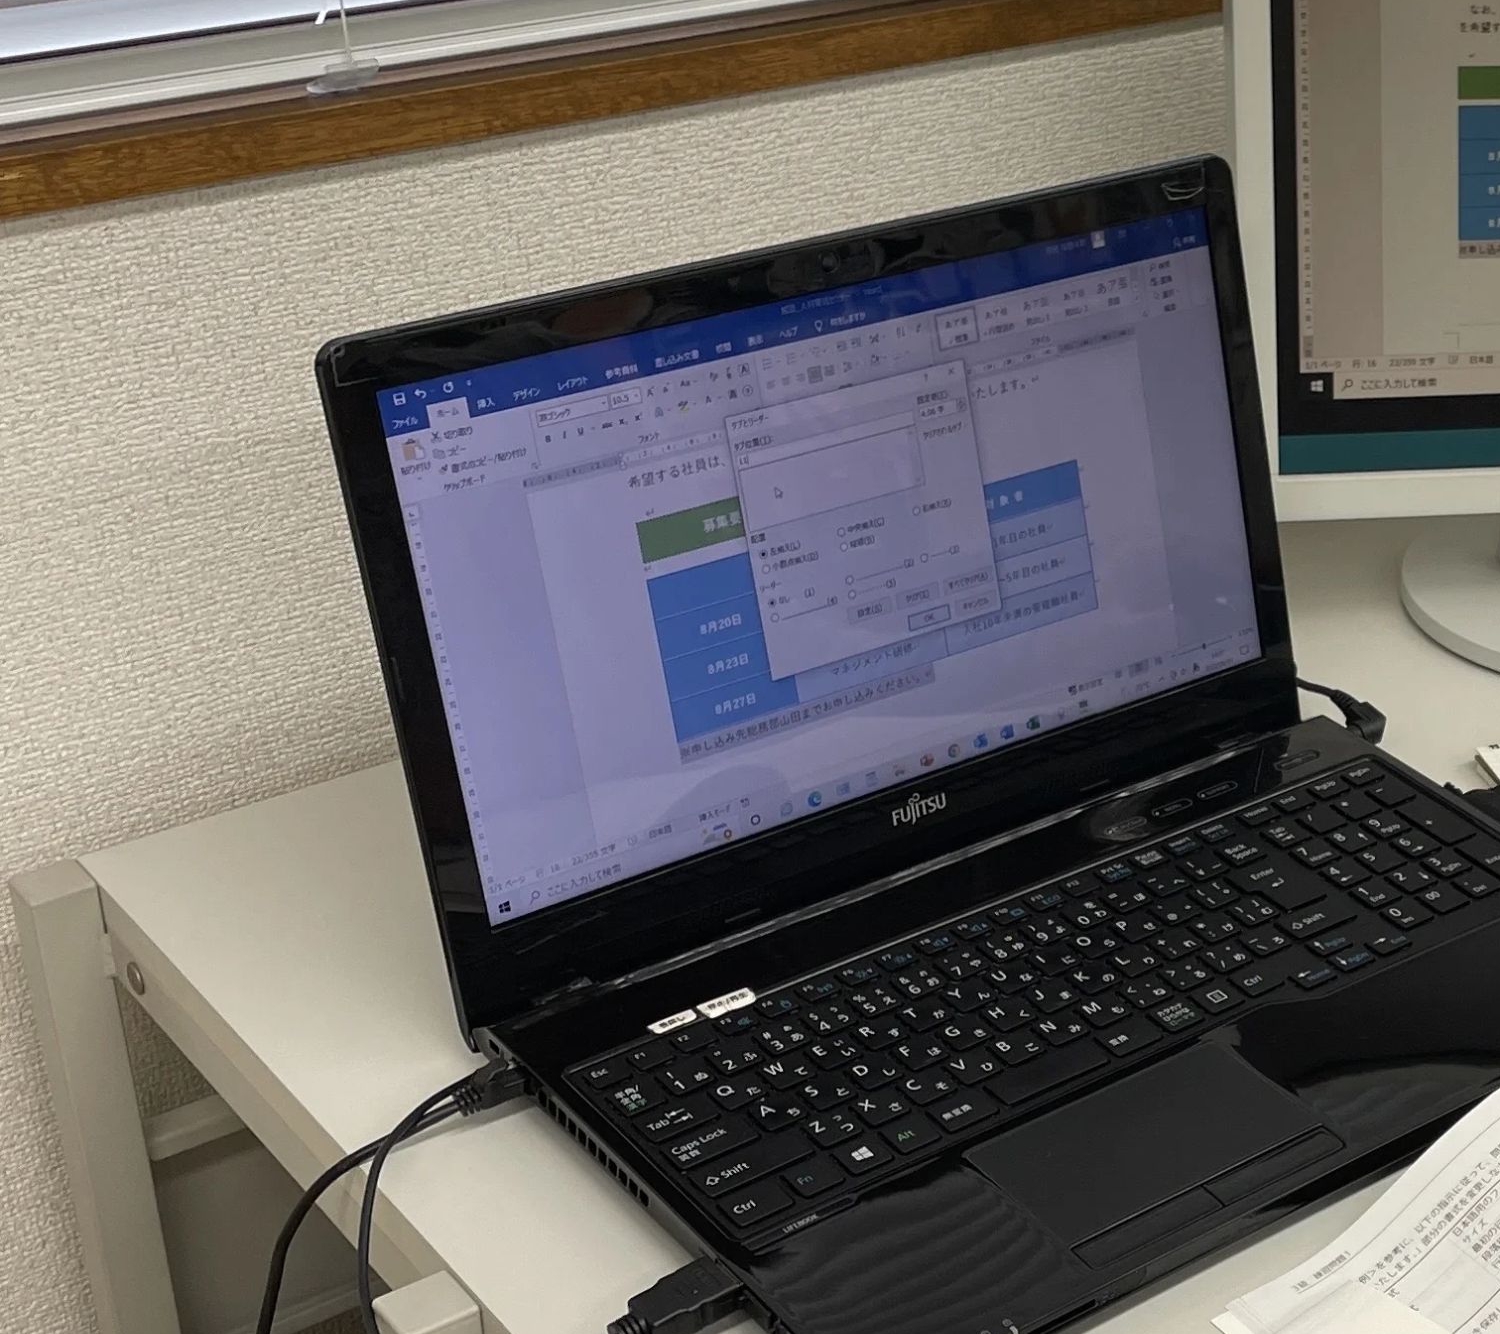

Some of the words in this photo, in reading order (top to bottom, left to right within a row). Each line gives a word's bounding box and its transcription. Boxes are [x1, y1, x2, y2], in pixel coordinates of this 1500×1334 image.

[556, 375, 589, 393] レイアウト
[512, 385, 542, 401] デザイン
[476, 397, 496, 411] 挿入
[391, 415, 420, 430] ファイル
[627, 453, 728, 491] 希望する社員は、
[700, 612, 744, 637] 8月20日
[707, 652, 750, 675] 8月23日
[714, 691, 757, 716] 8月27日
[891, 792, 948, 827] FUJITSU
[1249, 866, 1275, 881] Enter
[1301, 911, 1327, 927] Shift
[1075, 935, 1092, 948] O
[1243, 974, 1264, 989] Ctrl
[904, 1007, 918, 1019] T
[988, 1006, 1006, 1020] H
[1081, 1000, 1103, 1016] M
[1039, 1019, 1058, 1035] N
[590, 1067, 609, 1080] Esc
[763, 1061, 786, 1077] W
[716, 1084, 734, 1097] Q
[804, 1084, 820, 1098] S
[905, 1078, 923, 1093] C
[758, 1103, 777, 1118] A
[857, 1098, 877, 1113] X
[646, 1116, 671, 1133] Tab
[808, 1119, 826, 1135] Z
[670, 1136, 701, 1157] Caps
[698, 1126, 728, 1145] Lock
[896, 1129, 917, 1143] Alt
[719, 1161, 750, 1181] Shift
[796, 1172, 814, 1187] Fn
[732, 1198, 758, 1216] Ctrl
[1461, 1219, 1488, 1245] サイズ
